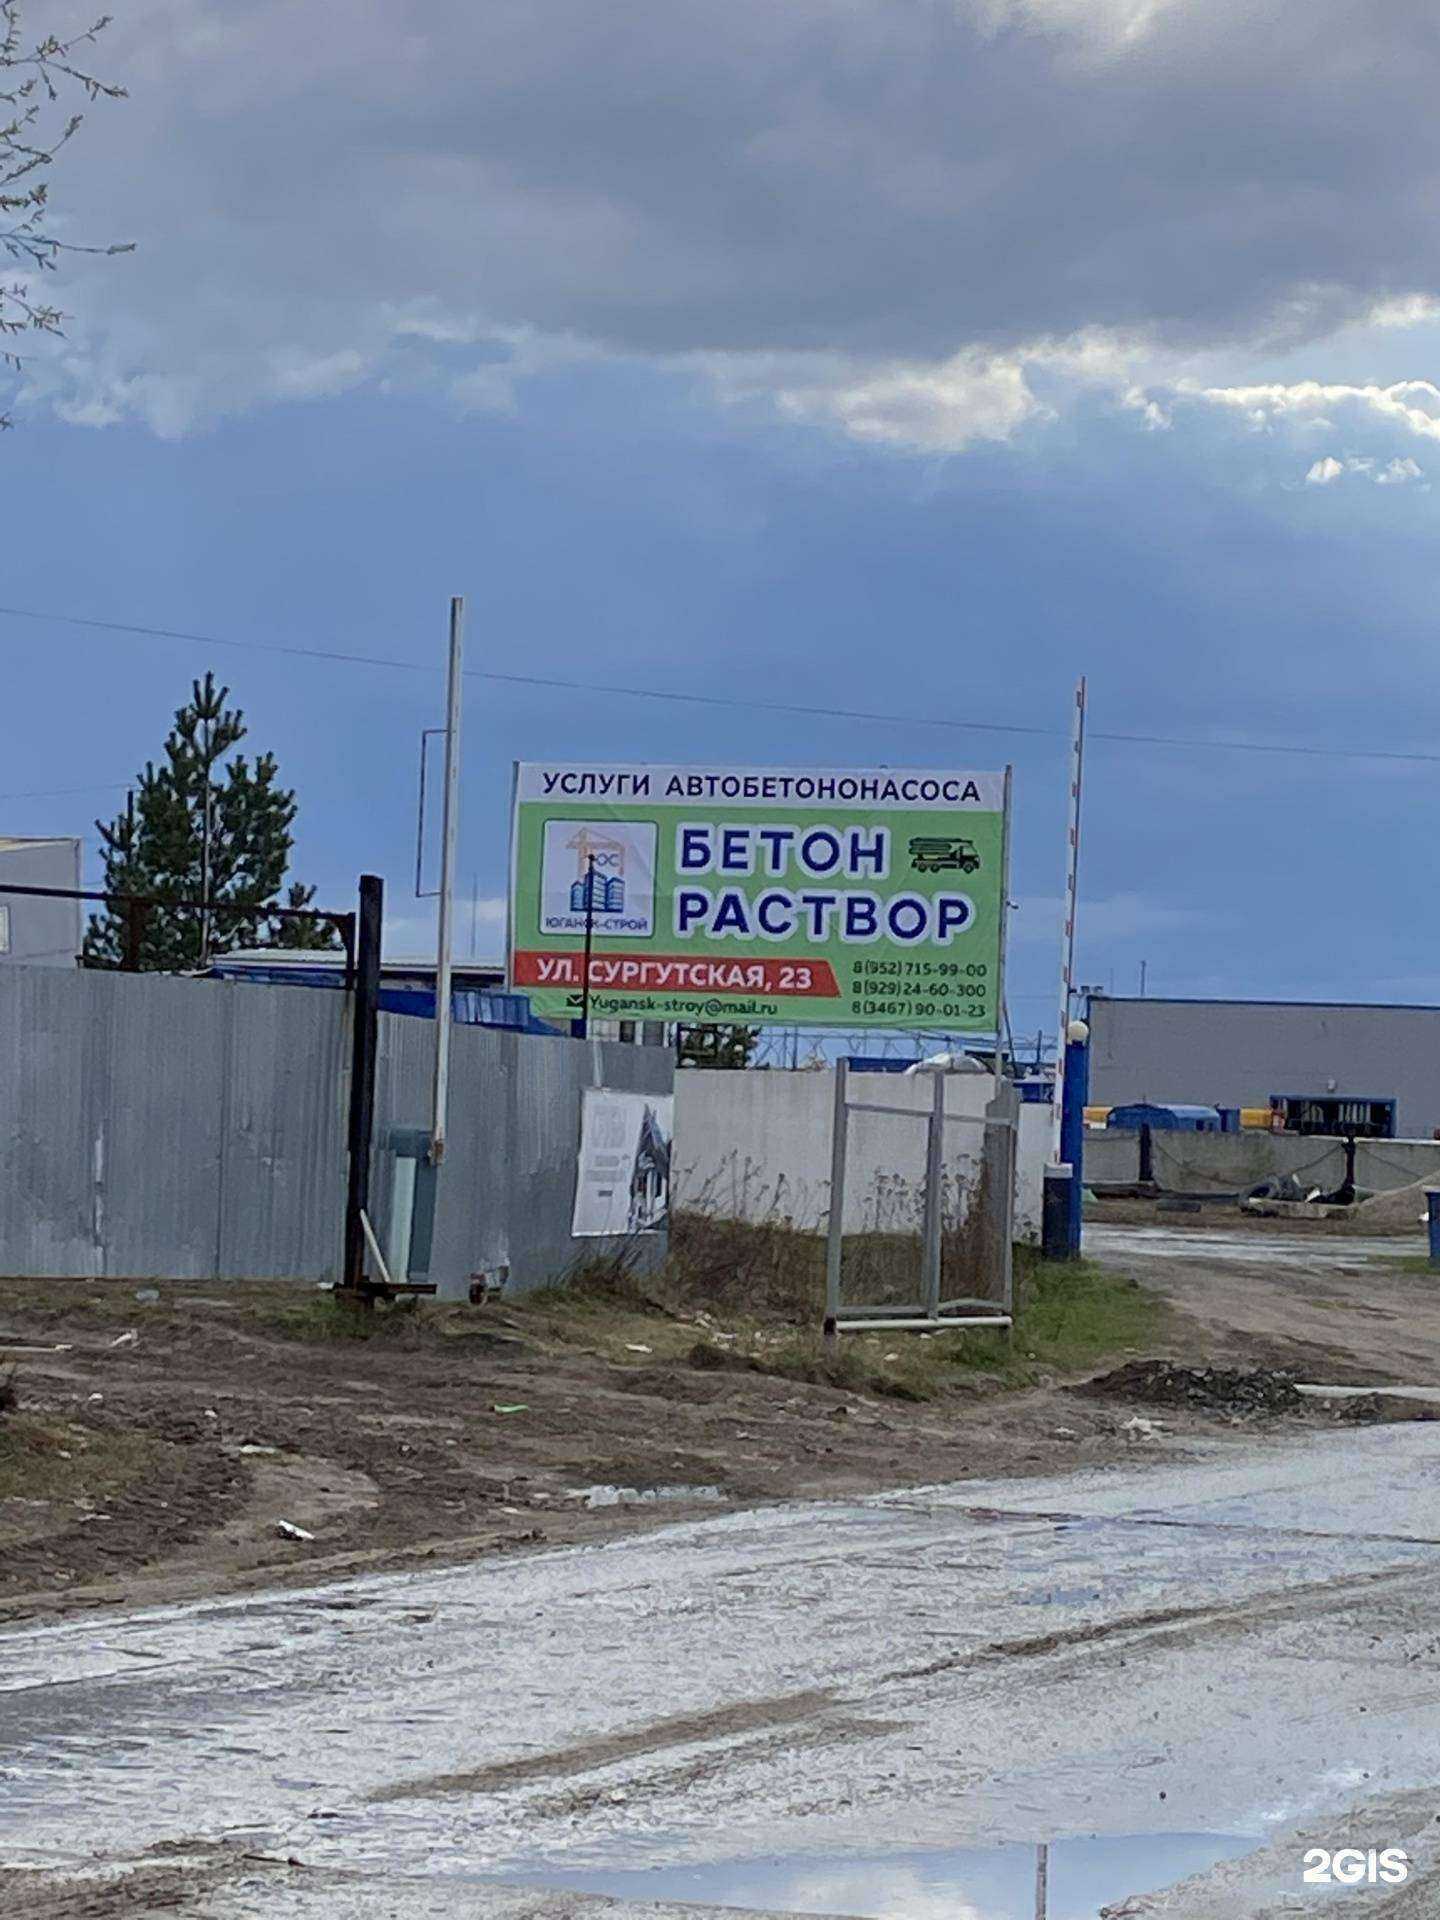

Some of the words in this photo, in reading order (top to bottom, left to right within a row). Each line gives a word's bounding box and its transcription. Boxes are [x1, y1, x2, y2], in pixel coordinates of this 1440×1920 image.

[543, 772, 651, 796] УСЛУГИ
[665, 774, 981, 802] АВТОБЕТОНОНАСОСА
[681, 829, 885, 874] БЕТОН
[545, 917, 648, 931] ЮГАНК-СТРОЙ
[678, 892, 970, 940] РАСТВОР
[537, 958, 579, 981] УЛ.
[587, 960, 772, 992] СУРГУТСКАЯ,
[779, 966, 812, 990] 23
